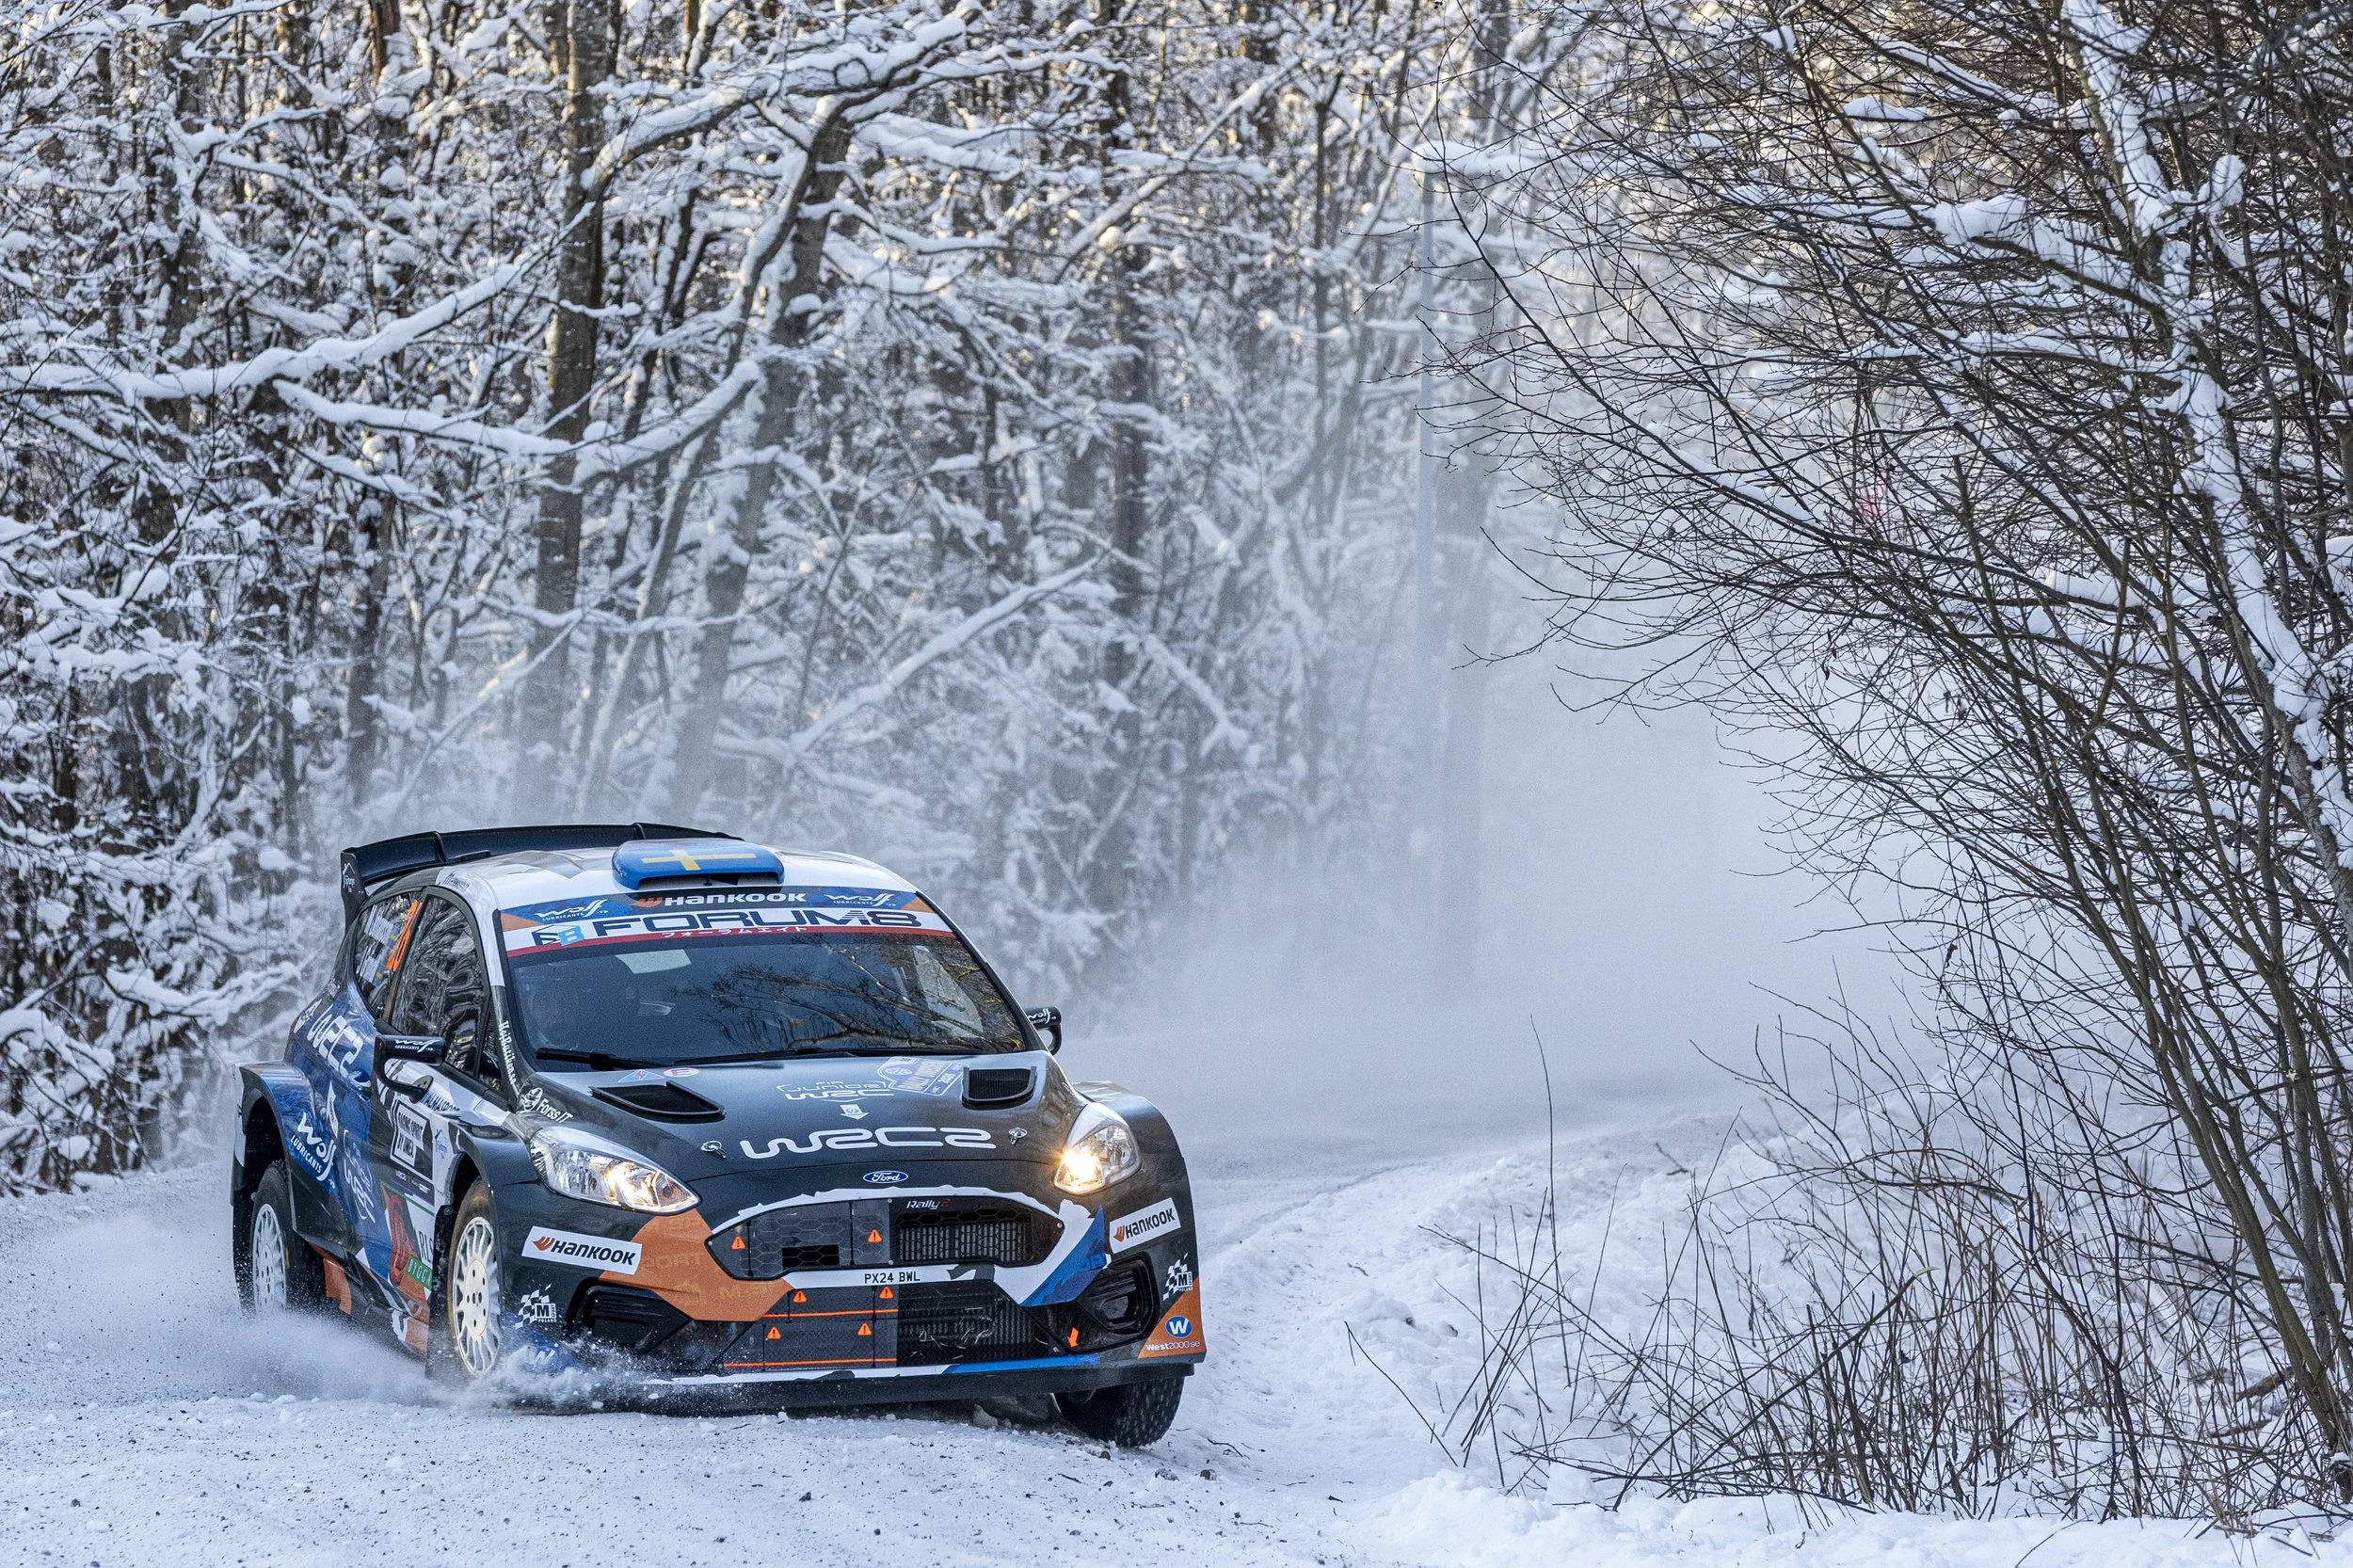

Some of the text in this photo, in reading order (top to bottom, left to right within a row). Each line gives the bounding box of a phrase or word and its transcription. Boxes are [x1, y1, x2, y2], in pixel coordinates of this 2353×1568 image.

[542, 911, 584, 921] LUBRICANTS
[591, 909, 922, 937] FORUM8
[661, 926, 808, 938] フォーラムエイト
[784, 1089, 895, 1100] WRC
[536, 1097, 574, 1124] Forss IT
[739, 1127, 997, 1160] WRC2
[290, 1134, 324, 1175] LUBRICANTS
[870, 1171, 902, 1183] Ford
[864, 1271, 920, 1285] PX24 BWL
[1168, 1318, 1190, 1336] W
